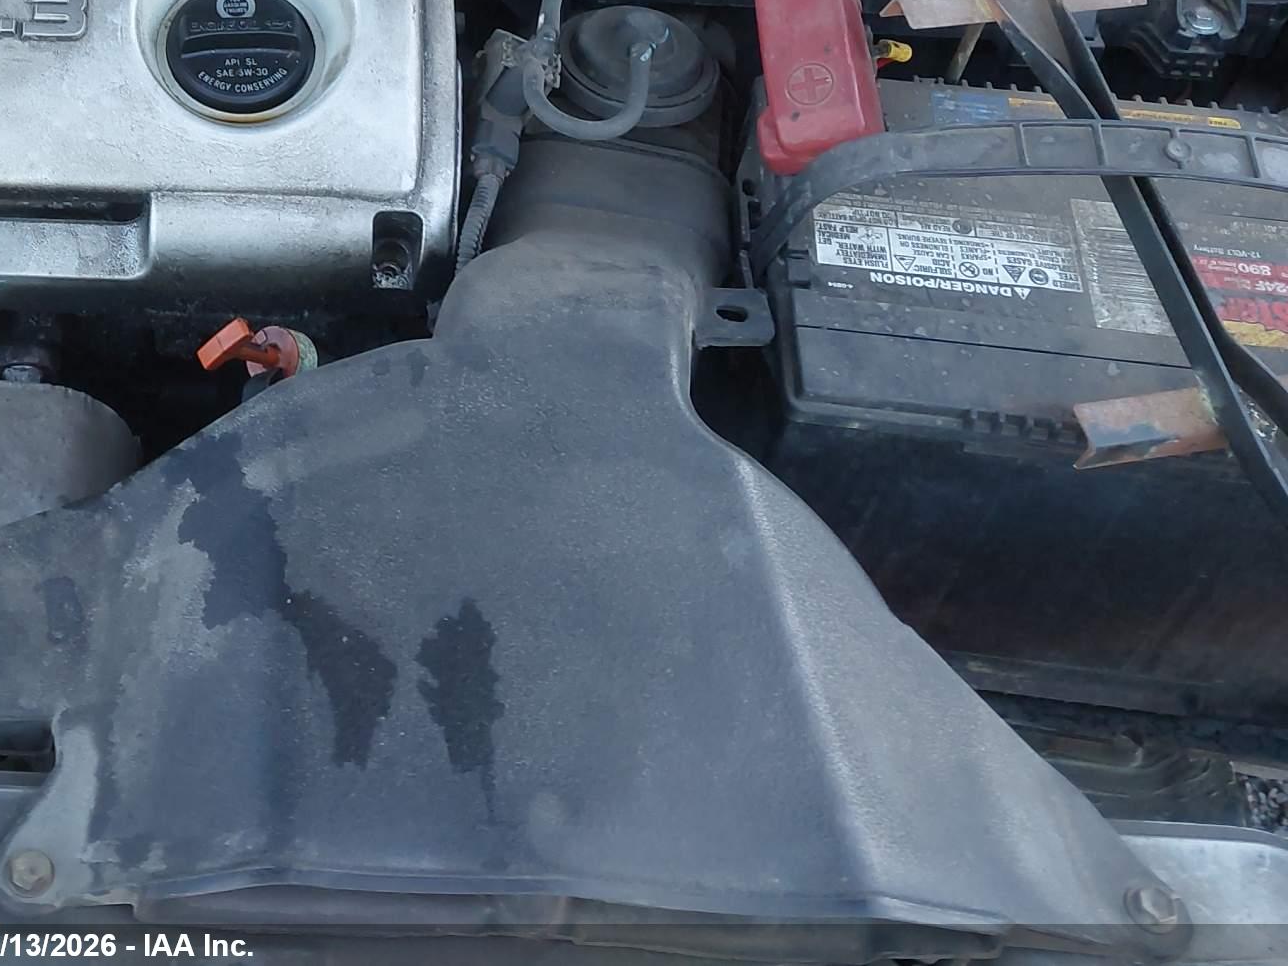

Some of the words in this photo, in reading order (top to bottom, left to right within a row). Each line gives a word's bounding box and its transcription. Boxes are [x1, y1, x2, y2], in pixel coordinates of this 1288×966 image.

[216, 69, 234, 77] SAE
[239, 68, 268, 76] 5W-30
[198, 72, 232, 91] ENERGY
[235, 68, 288, 92] CONSERVING
[839, 225, 858, 233] HELP
[867, 245, 886, 253] WITH
[1194, 245, 1224, 254] Battery
[836, 249, 887, 260] IMMEDIATELY
[843, 257, 862, 265] EYES
[864, 260, 888, 268] FLUSH
[1007, 257, 1032, 266] GASES
[913, 265, 952, 276] SULFURIC
[1239, 263, 1272, 276] 890
[870, 271, 1012, 296] DANGER/POISON
